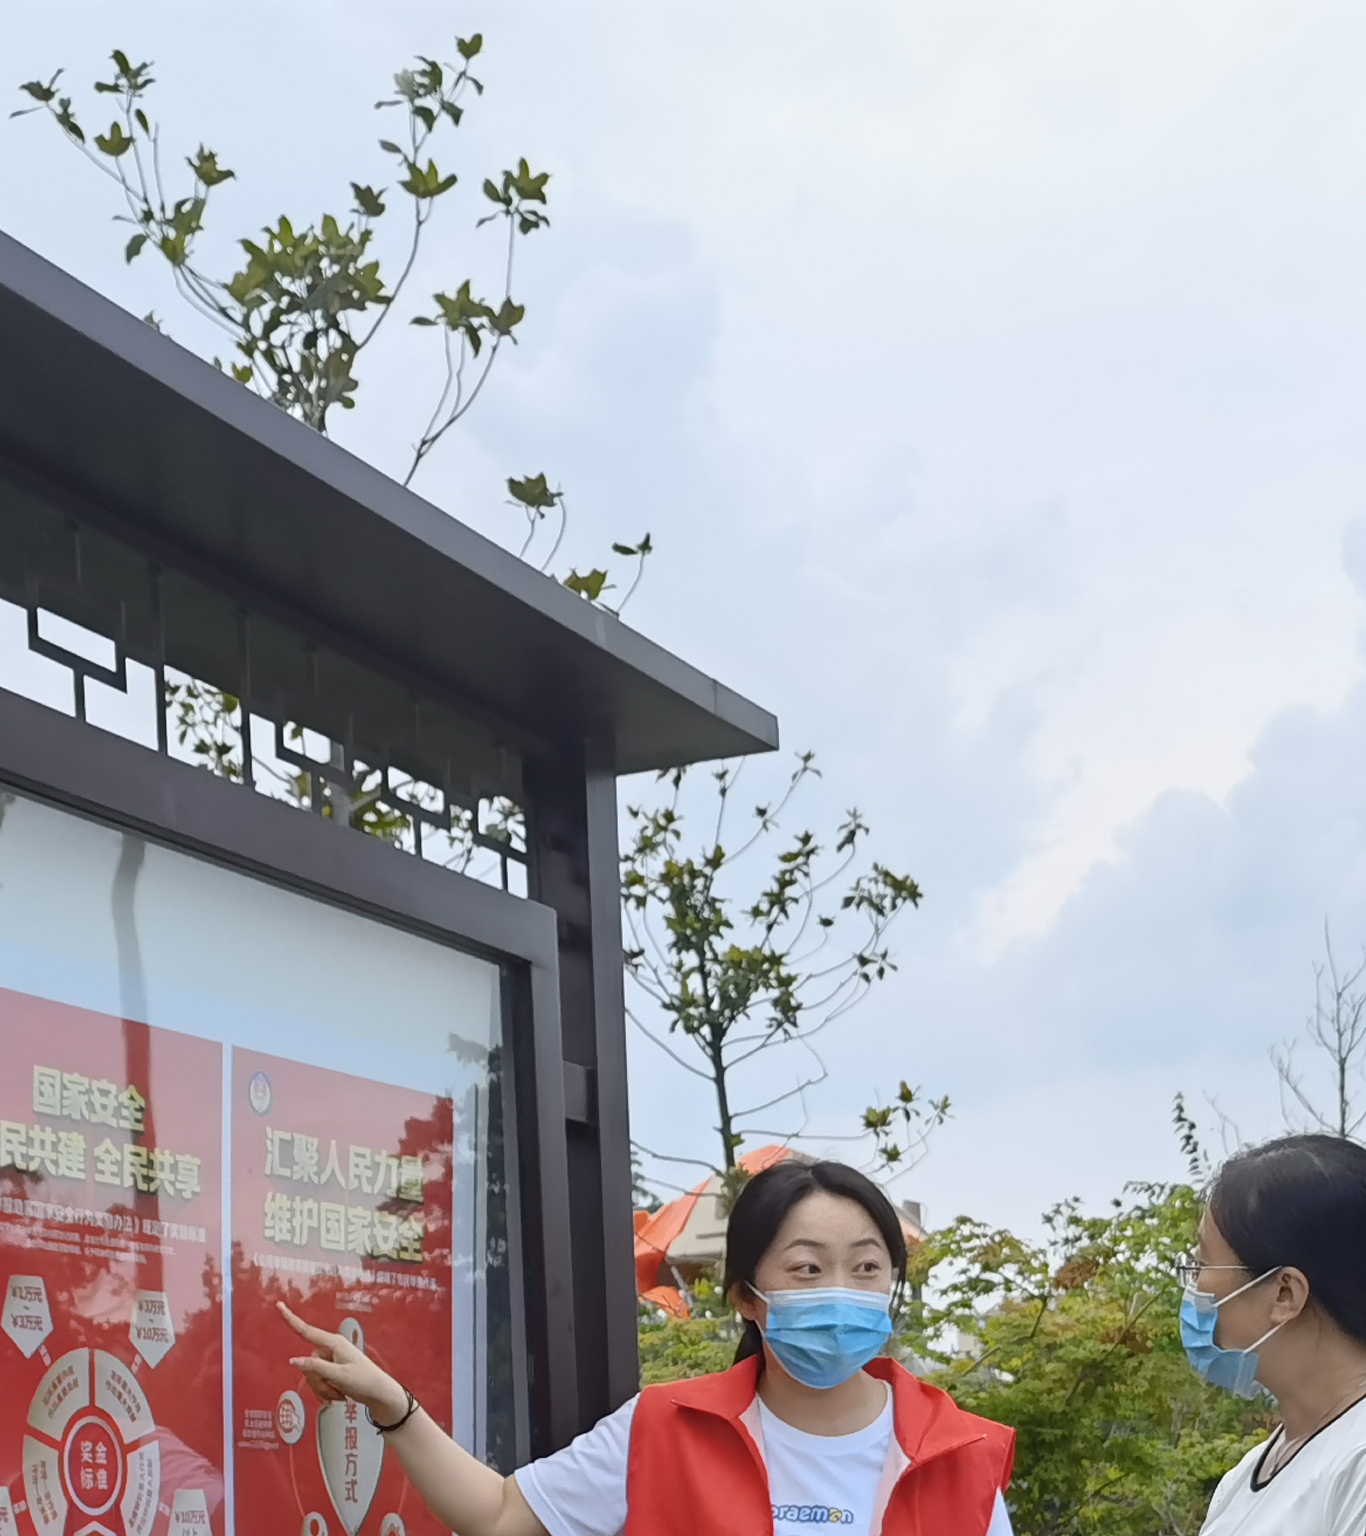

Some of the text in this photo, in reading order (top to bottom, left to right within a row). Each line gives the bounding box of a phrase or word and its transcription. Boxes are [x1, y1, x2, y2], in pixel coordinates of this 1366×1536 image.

[31, 1064, 146, 1133] 国家安全
[92, 1137, 203, 1200] 全民共享
[264, 1125, 425, 1203] 汇聚人民力量
[264, 1190, 425, 1263] 维护国家安全
[344, 1398, 359, 1504] 举报方式
[771, 1504, 854, 1524] oraemon
